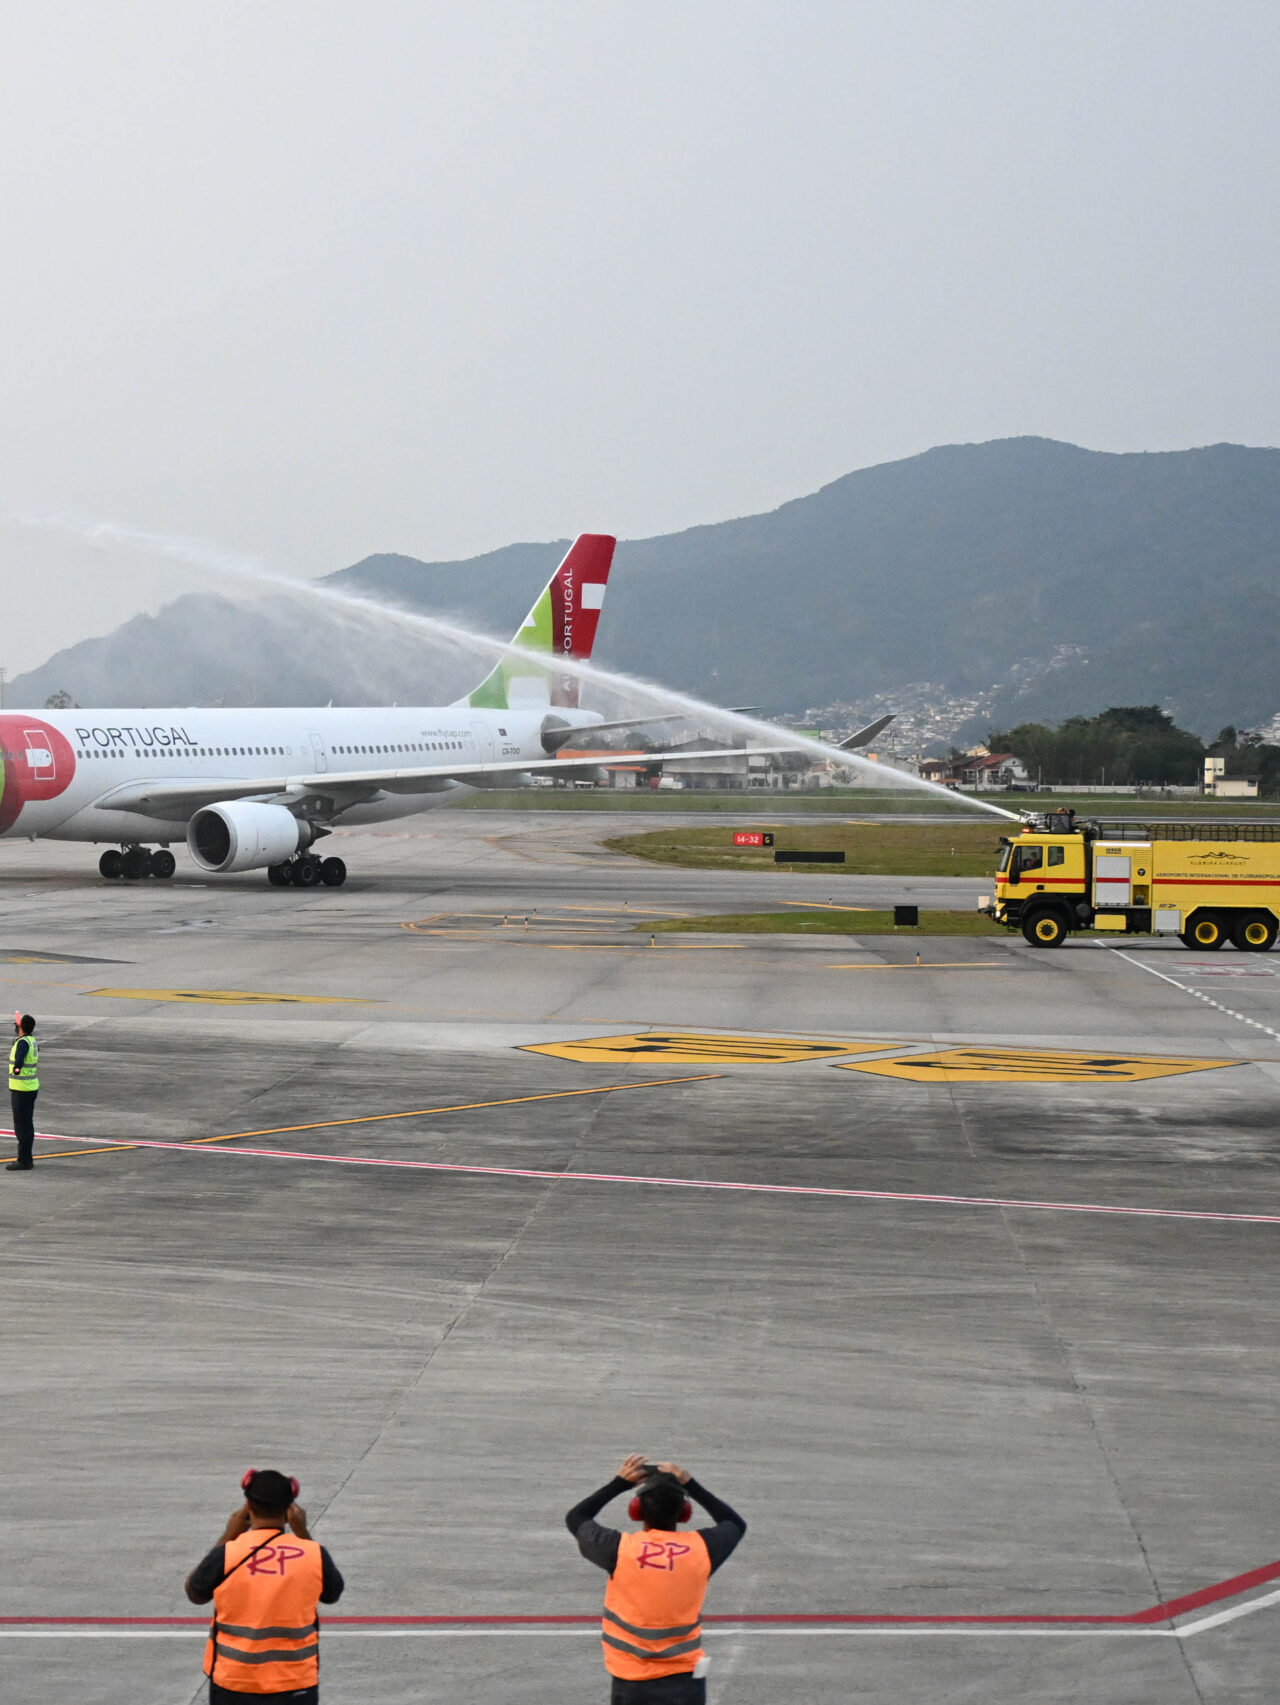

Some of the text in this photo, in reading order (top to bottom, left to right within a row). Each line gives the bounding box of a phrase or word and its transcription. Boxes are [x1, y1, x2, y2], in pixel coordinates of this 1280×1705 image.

[562, 567, 574, 660] PORTUGAL
[75, 726, 199, 748] PORTUGAL
[420, 727, 473, 739] www.flytap.com
[737, 835, 759, 844] 14-32
[246, 1545, 305, 1576] RP
[636, 1542, 690, 1571] RP
